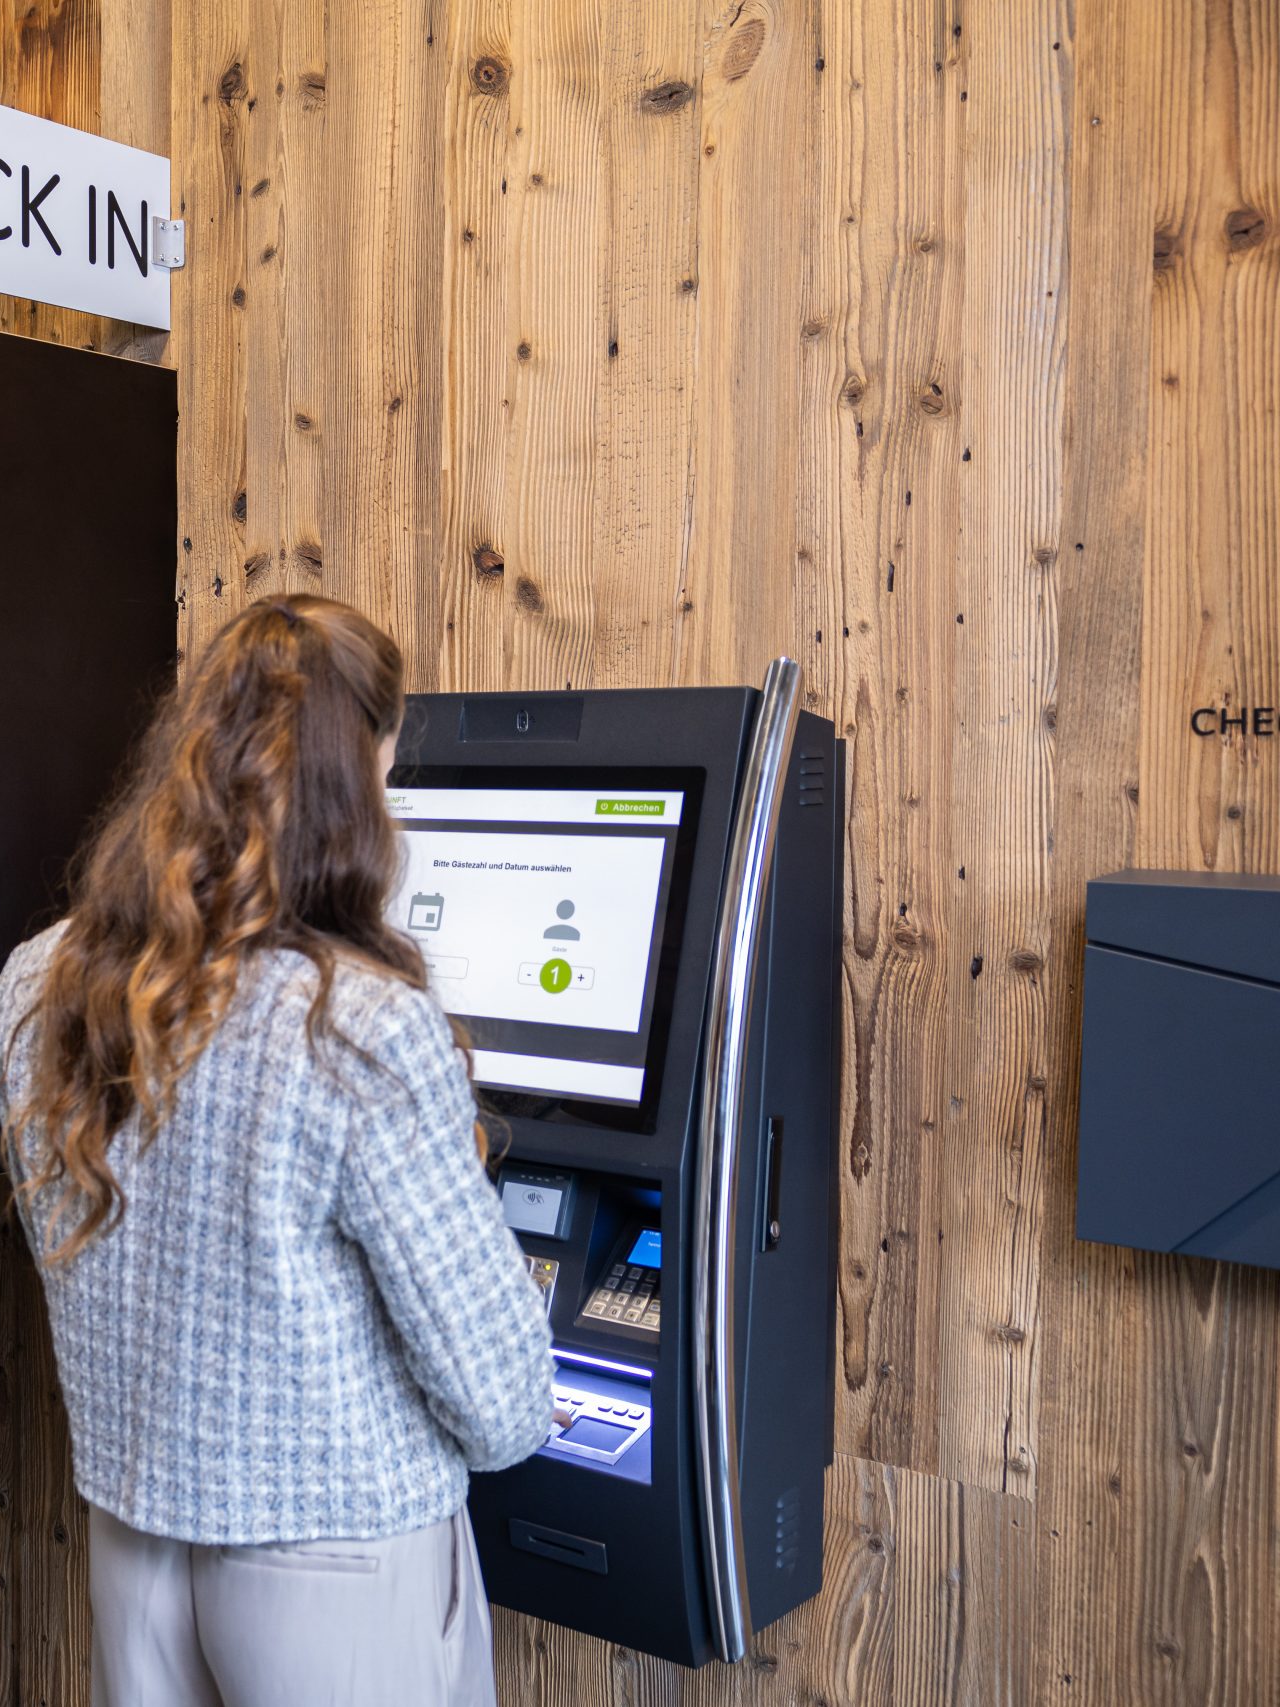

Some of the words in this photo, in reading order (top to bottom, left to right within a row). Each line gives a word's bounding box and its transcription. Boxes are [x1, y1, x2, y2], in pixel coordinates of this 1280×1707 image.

[88, 185, 148, 278] IN
[1191, 707, 1280, 736] CHE
[613, 802, 659, 813] Abbrechen
[451, 860, 487, 869] Gästezahl
[504, 863, 529, 871] Datum
[530, 864, 572, 873] auswählen
[550, 965, 559, 985] 1
